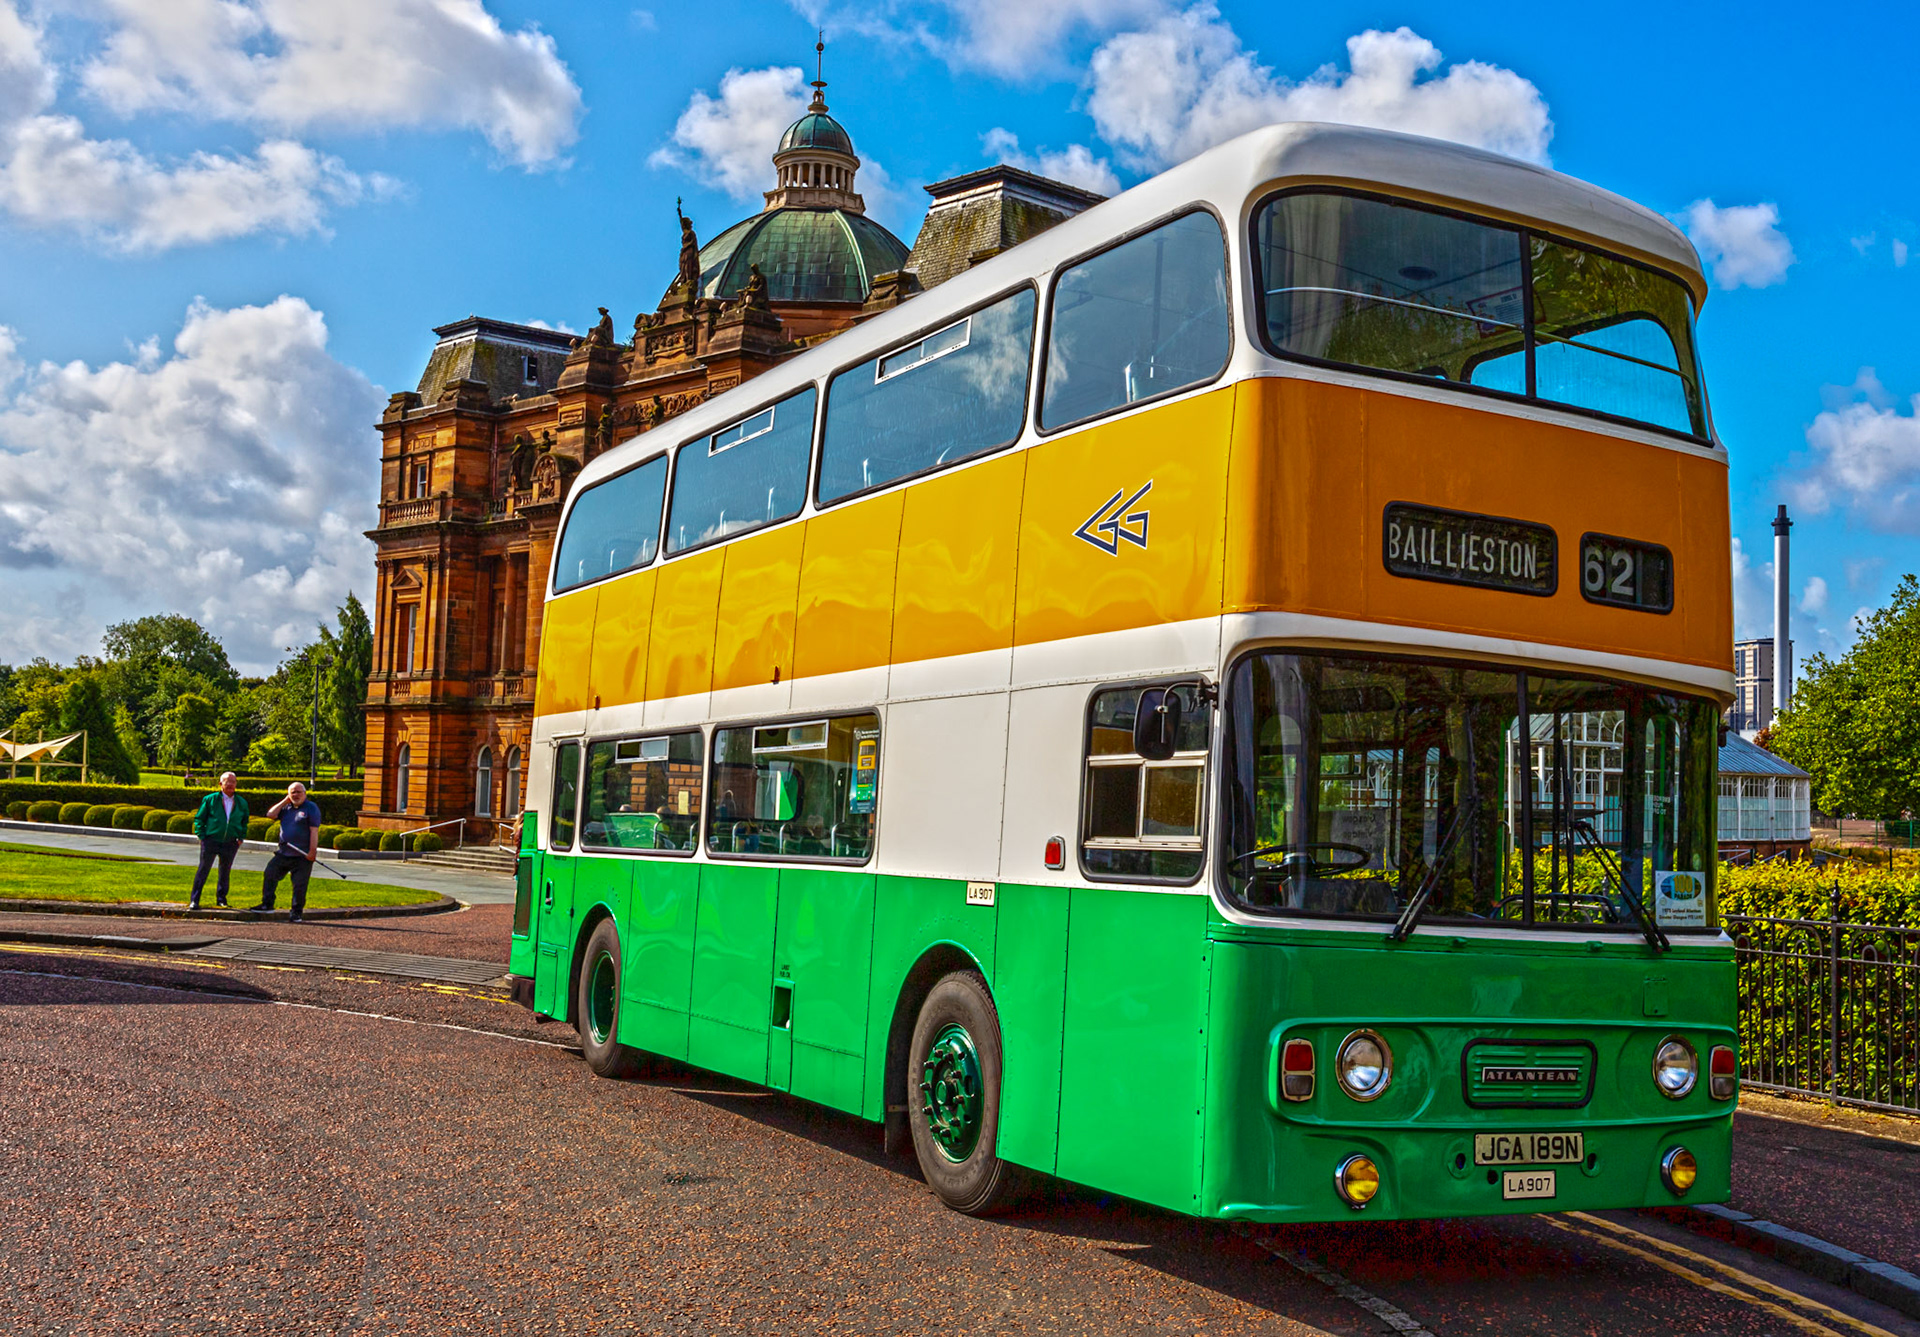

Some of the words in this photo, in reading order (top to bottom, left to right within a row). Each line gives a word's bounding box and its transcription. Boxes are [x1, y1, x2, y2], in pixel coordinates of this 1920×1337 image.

[1389, 522, 1537, 580] BAILLIESTON
[1584, 548, 1635, 597] 62
[1674, 874, 1693, 893] 100
[1486, 1071, 1577, 1081] ATLANTEAN
[1481, 1136, 1524, 1161] JGA
[1530, 1135, 1579, 1161] 189N
[1508, 1177, 1551, 1193] LA907
